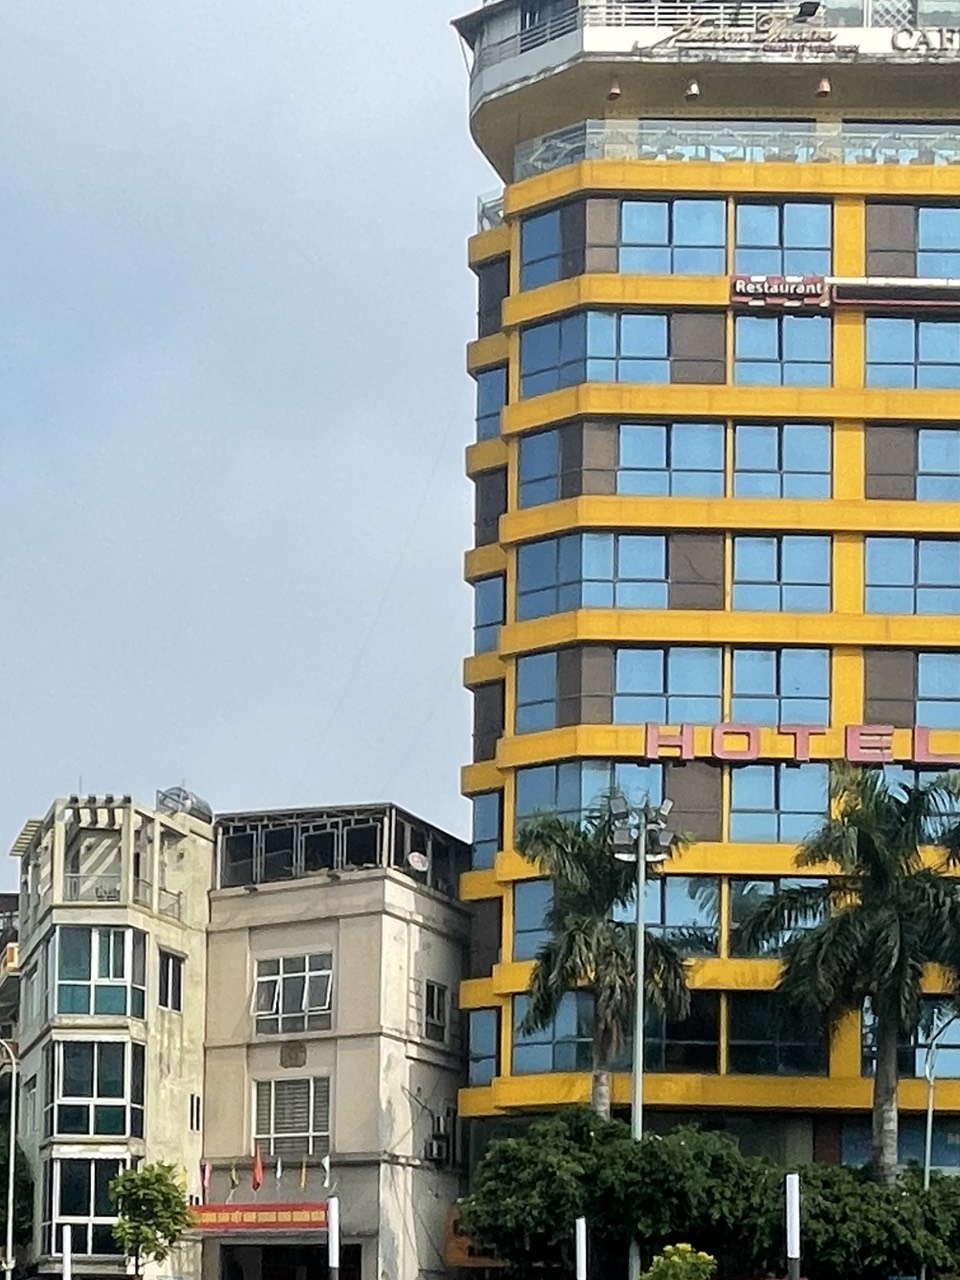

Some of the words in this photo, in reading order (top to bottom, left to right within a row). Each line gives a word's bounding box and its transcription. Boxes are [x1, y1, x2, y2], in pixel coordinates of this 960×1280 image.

[892, 28, 960, 51] CAF
[735, 279, 823, 294] Restaurant
[645, 722, 960, 763] HOTEL
